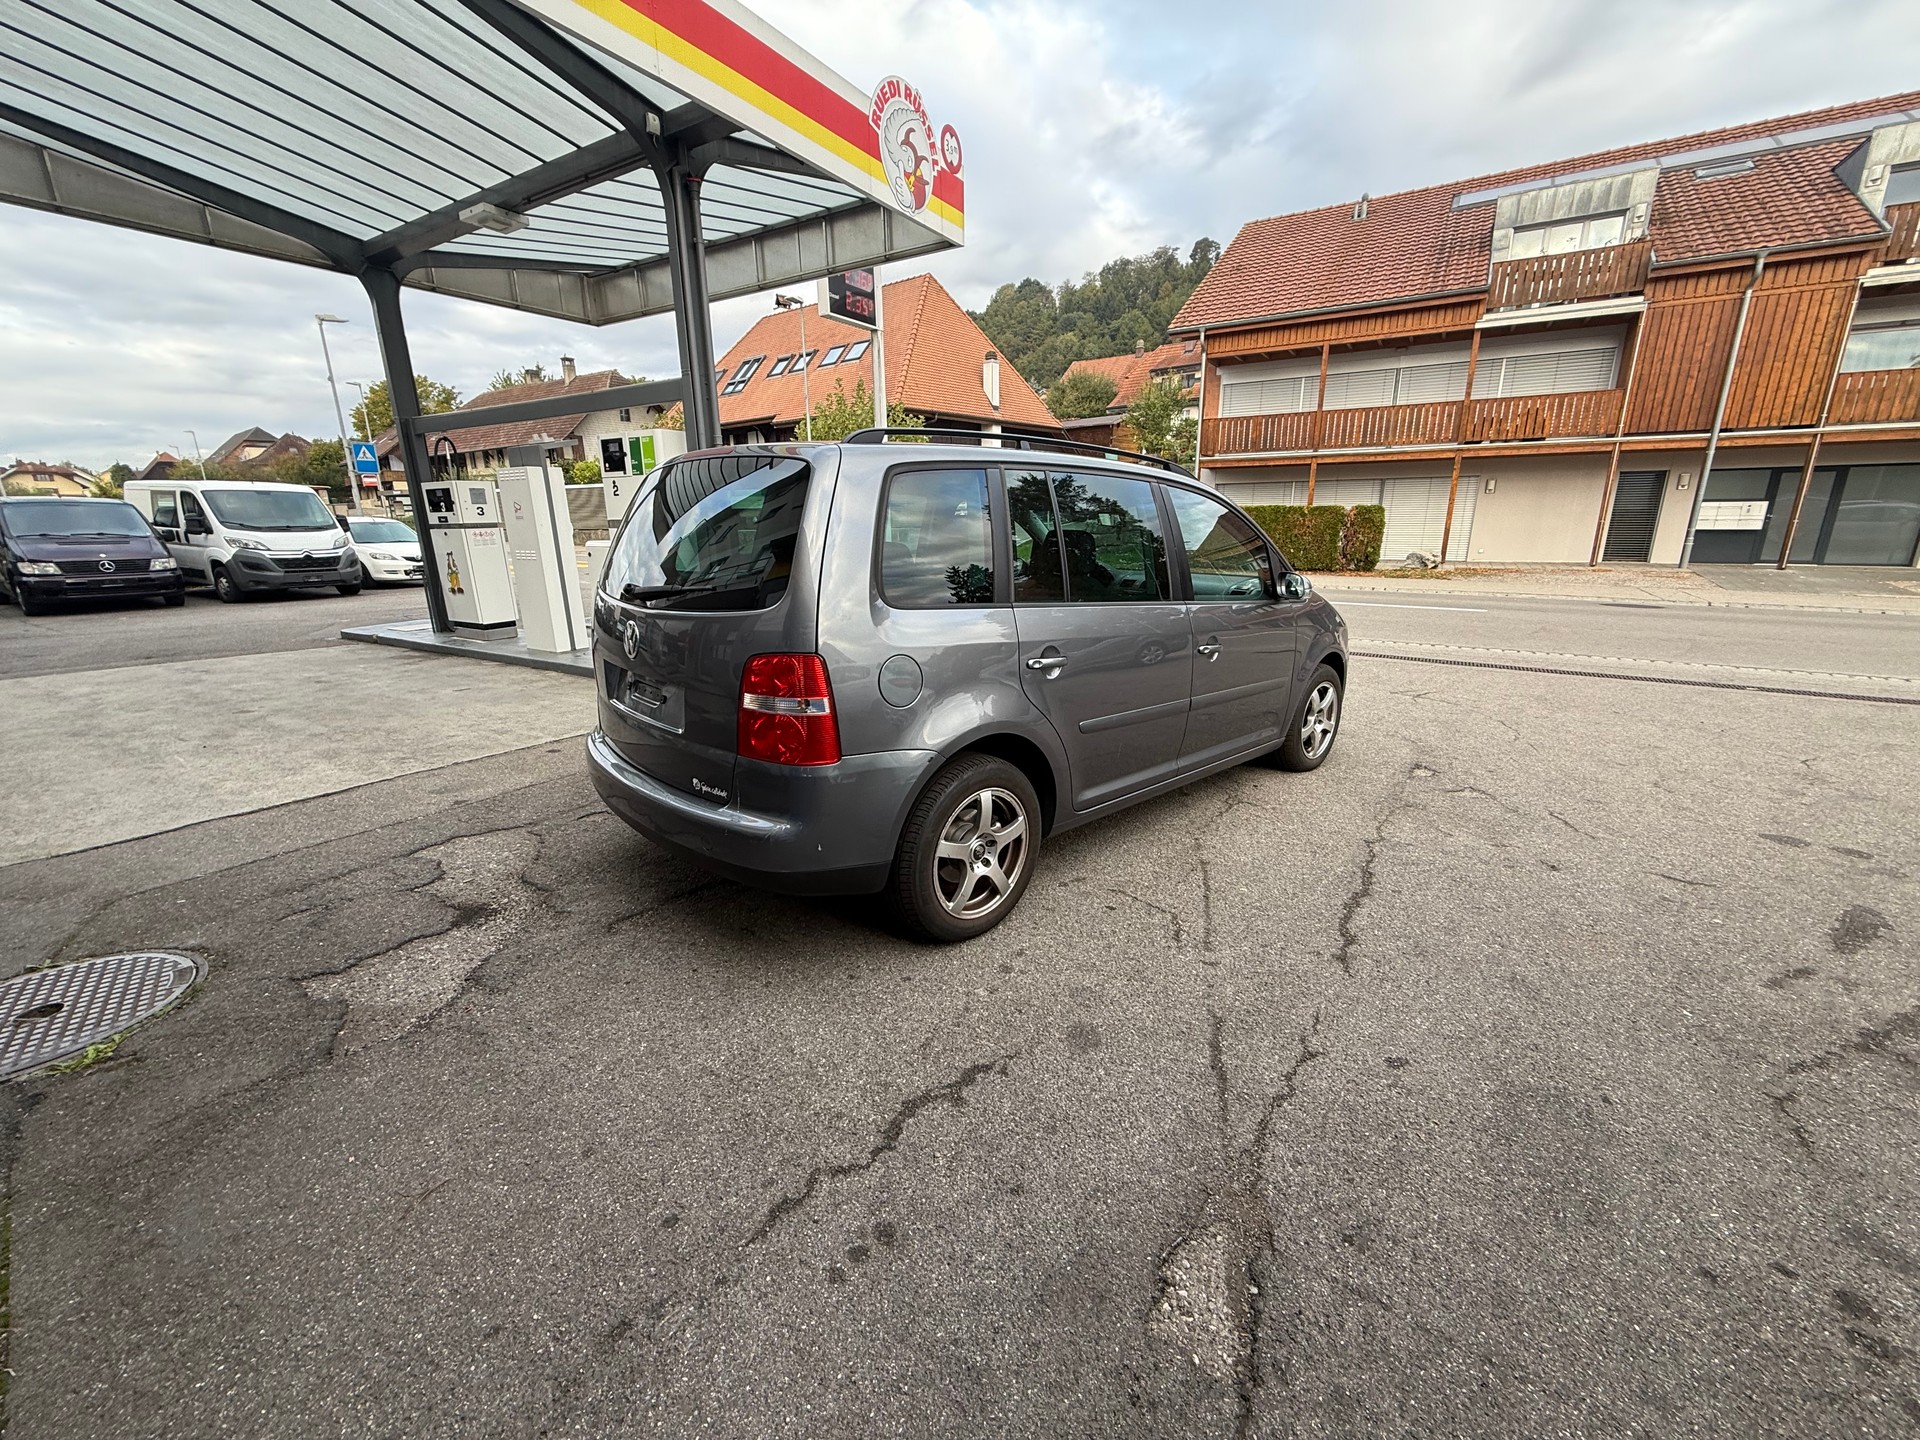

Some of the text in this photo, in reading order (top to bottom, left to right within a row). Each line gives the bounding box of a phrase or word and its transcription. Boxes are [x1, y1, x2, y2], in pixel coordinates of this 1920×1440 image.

[871, 80, 939, 172] RUEDI RÜSSEL
[612, 484, 620, 497] 2
[440, 501, 446, 512] 3
[476, 506, 485, 517] 3
